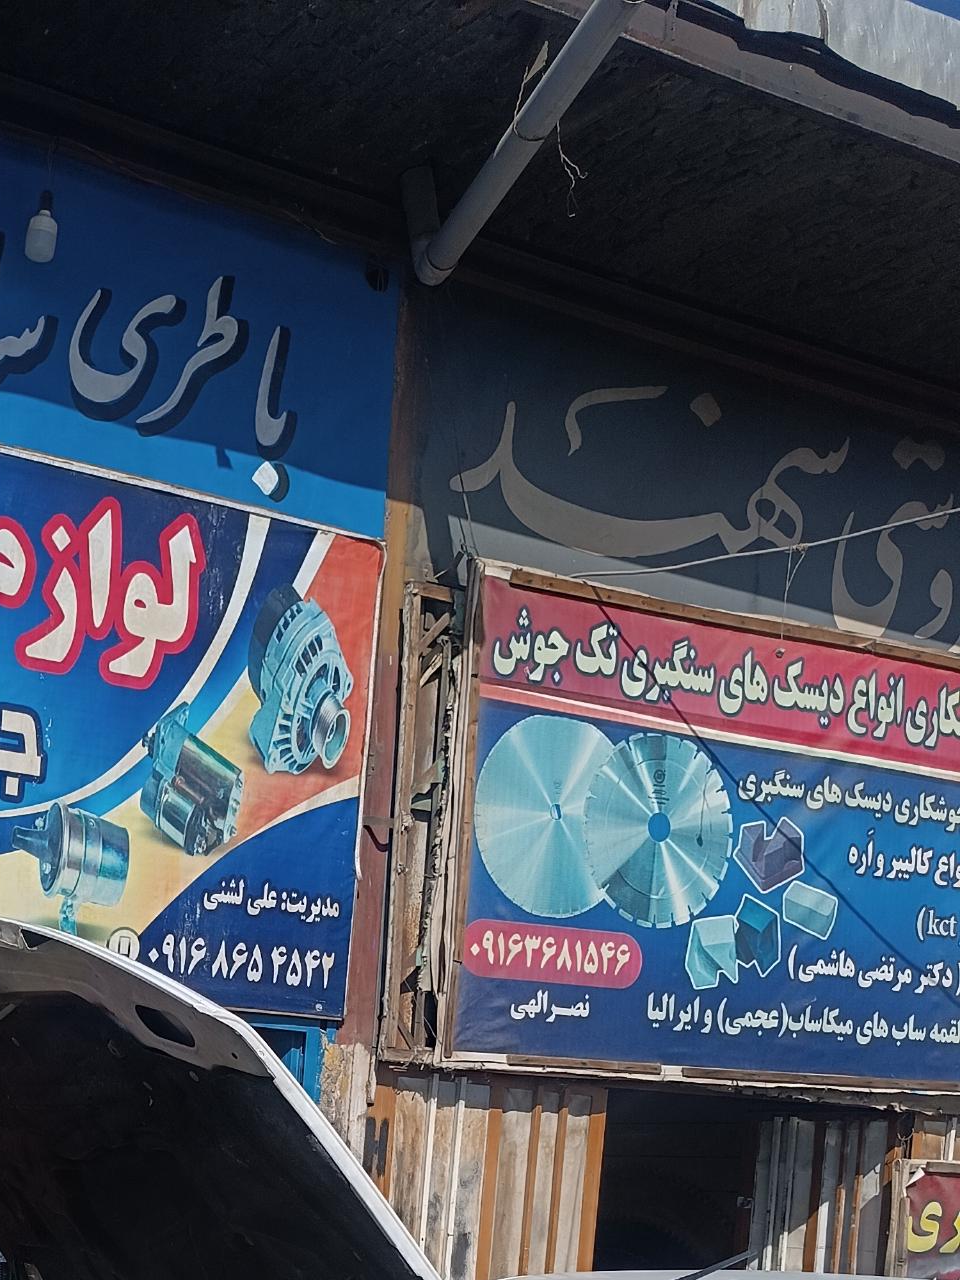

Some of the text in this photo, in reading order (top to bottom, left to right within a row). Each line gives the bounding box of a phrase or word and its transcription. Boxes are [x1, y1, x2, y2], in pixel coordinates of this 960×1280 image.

[493, 608, 570, 682] جوش
[575, 624, 618, 676] تک
[718, 650, 768, 715] های
[773, 660, 845, 726] دیسک
[846, 671, 904, 739] انواع
[739, 770, 805, 802] سنگبری
[806, 776, 842, 809] های
[845, 783, 892, 817] دیسک
[874, 856, 885, 877] و
[887, 845, 933, 879] کالیبر
[203, 879, 340, 922] مدیریت: علی لشنی
[149, 934, 335, 989] ۰۹۱۶ ۸۶۵ ۴۵۴۲
[470, 930, 631, 976] ۰۹۱۶۳۶۸۱۵۴۶
[857, 955, 912, 993] مرتضی
[700, 1009, 713, 1034] و
[855, 1011, 889, 1045] های
[891, 1014, 927, 1047] ساب
